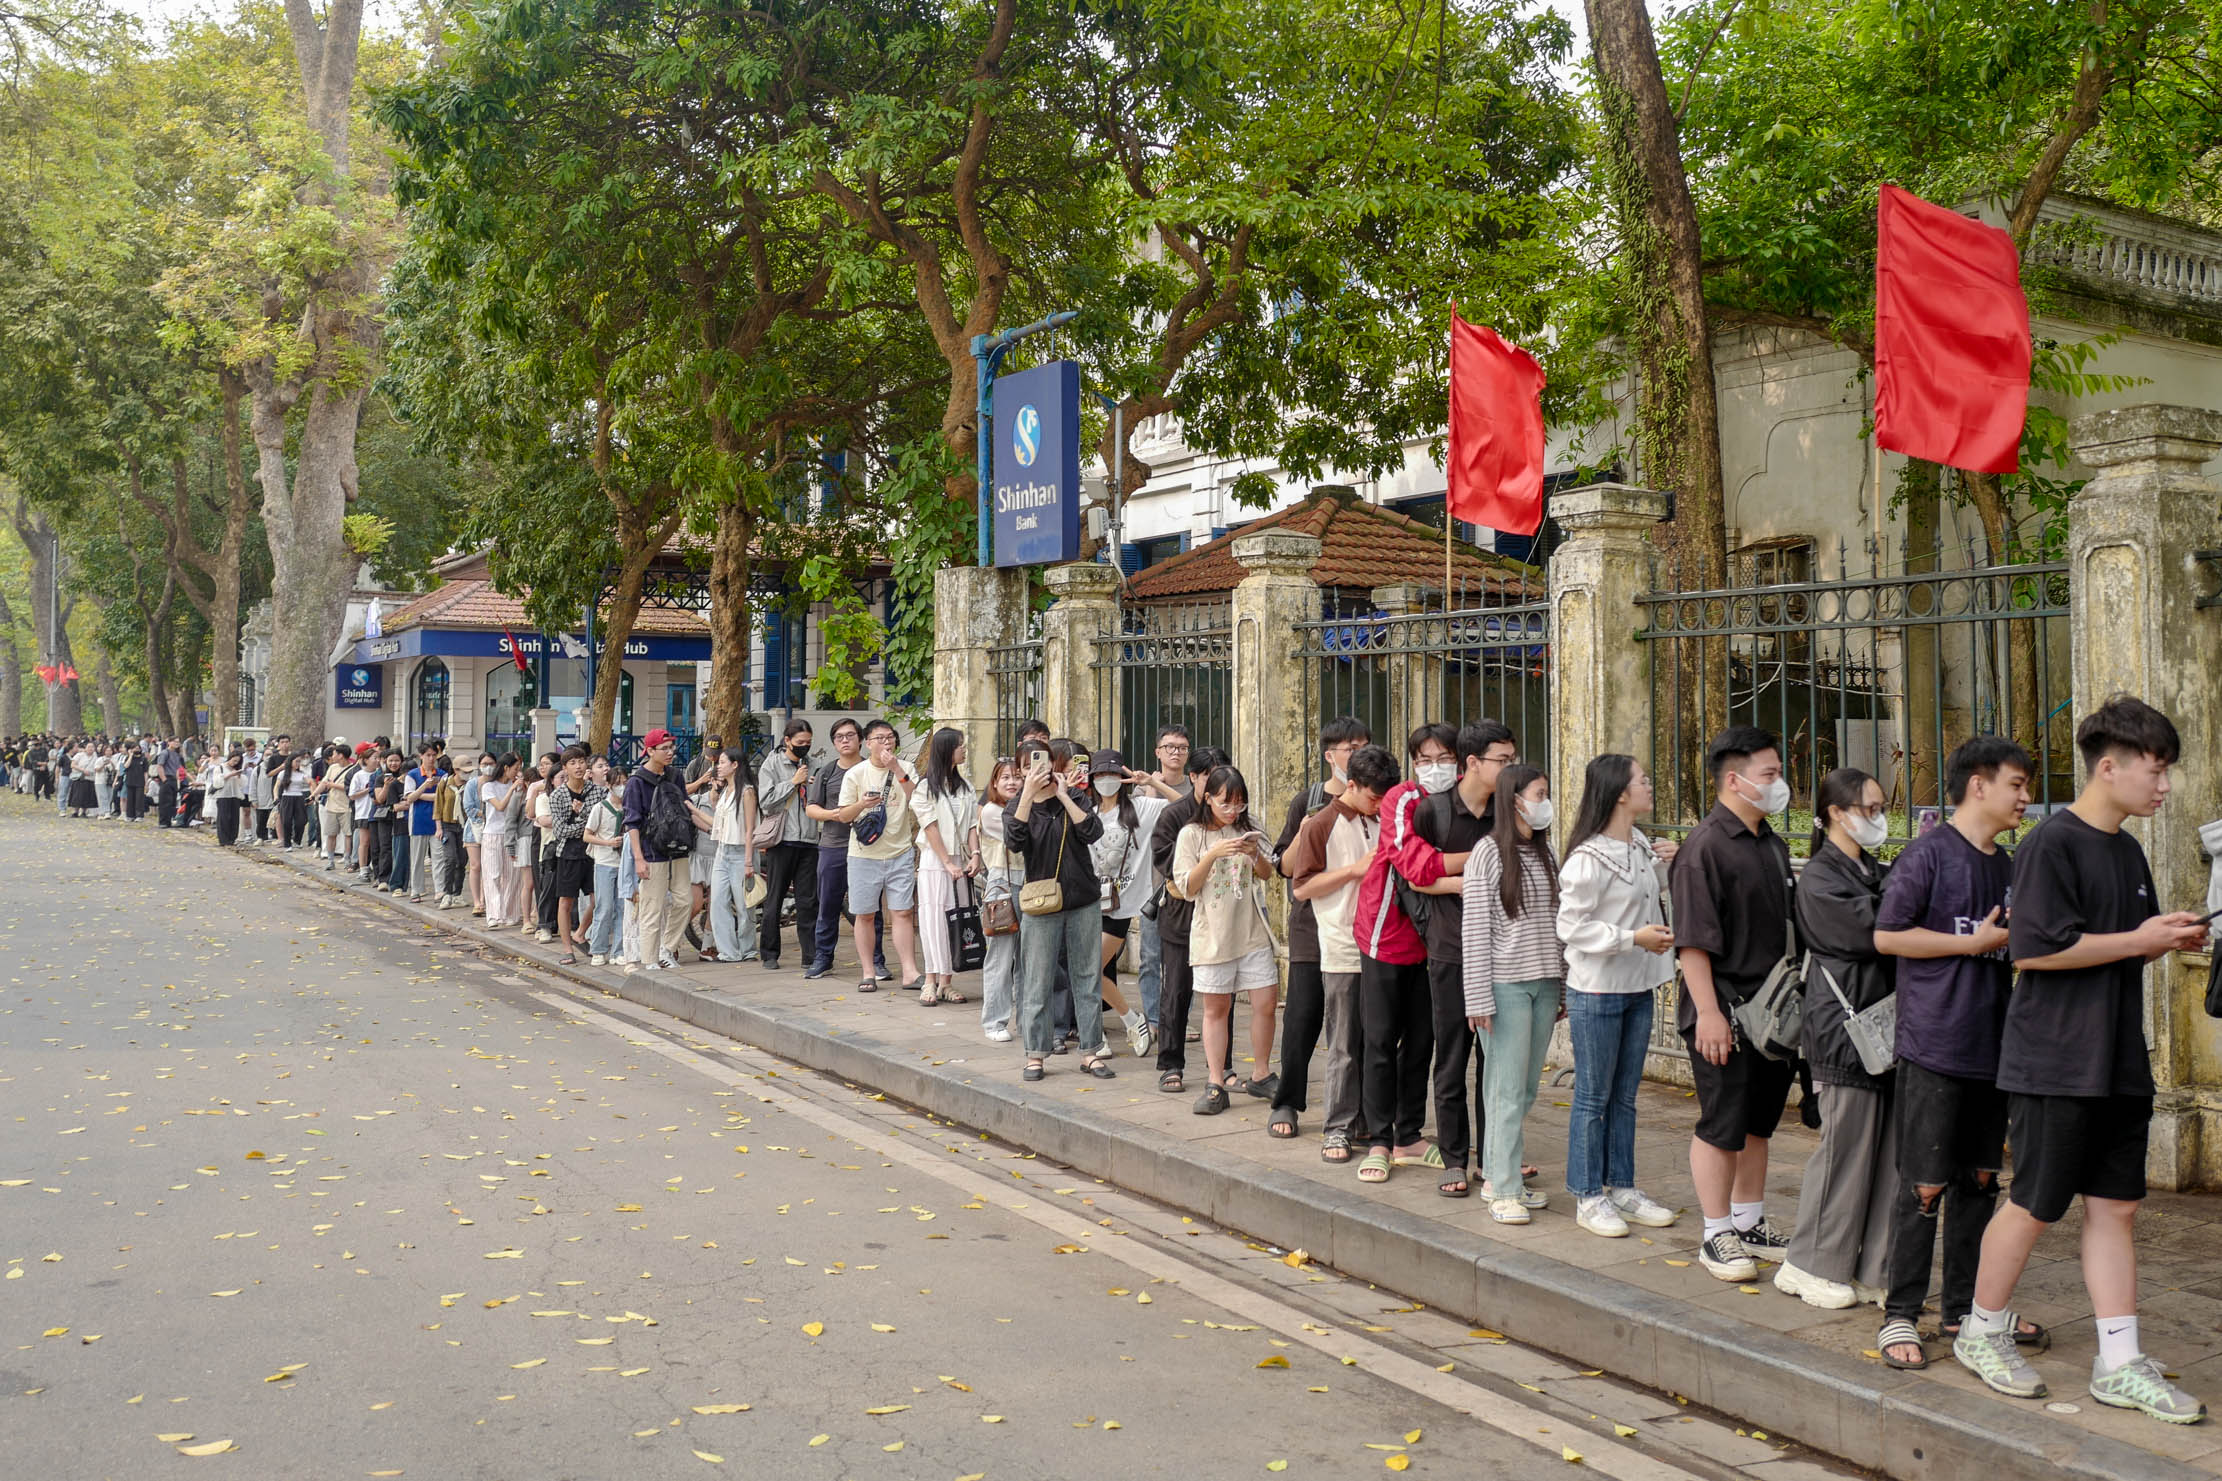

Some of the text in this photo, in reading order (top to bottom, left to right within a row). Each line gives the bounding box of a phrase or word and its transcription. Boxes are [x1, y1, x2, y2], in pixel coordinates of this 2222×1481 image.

[998, 481, 1057, 513] Shinhan
[1016, 512, 1038, 531] Bank
[499, 638, 560, 653] Sinhn
[341, 689, 378, 698] Shinhan
[344, 697, 363, 705] Digital
